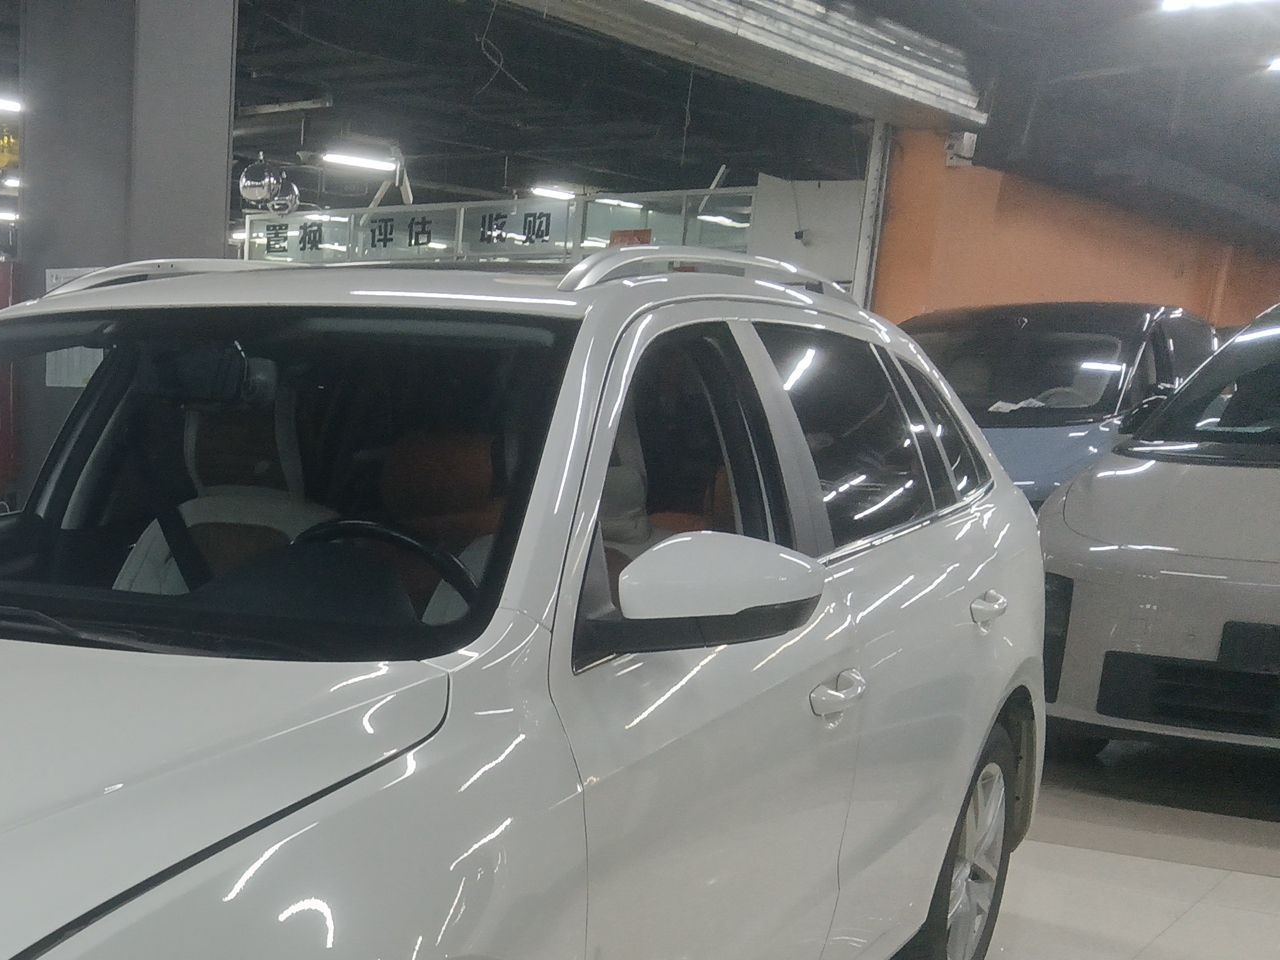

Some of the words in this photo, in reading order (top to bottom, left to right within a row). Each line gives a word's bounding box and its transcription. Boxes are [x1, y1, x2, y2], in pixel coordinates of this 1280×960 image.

[266, 222, 322, 253] 置换
[371, 216, 432, 248] 评估
[480, 211, 552, 244] 收购
